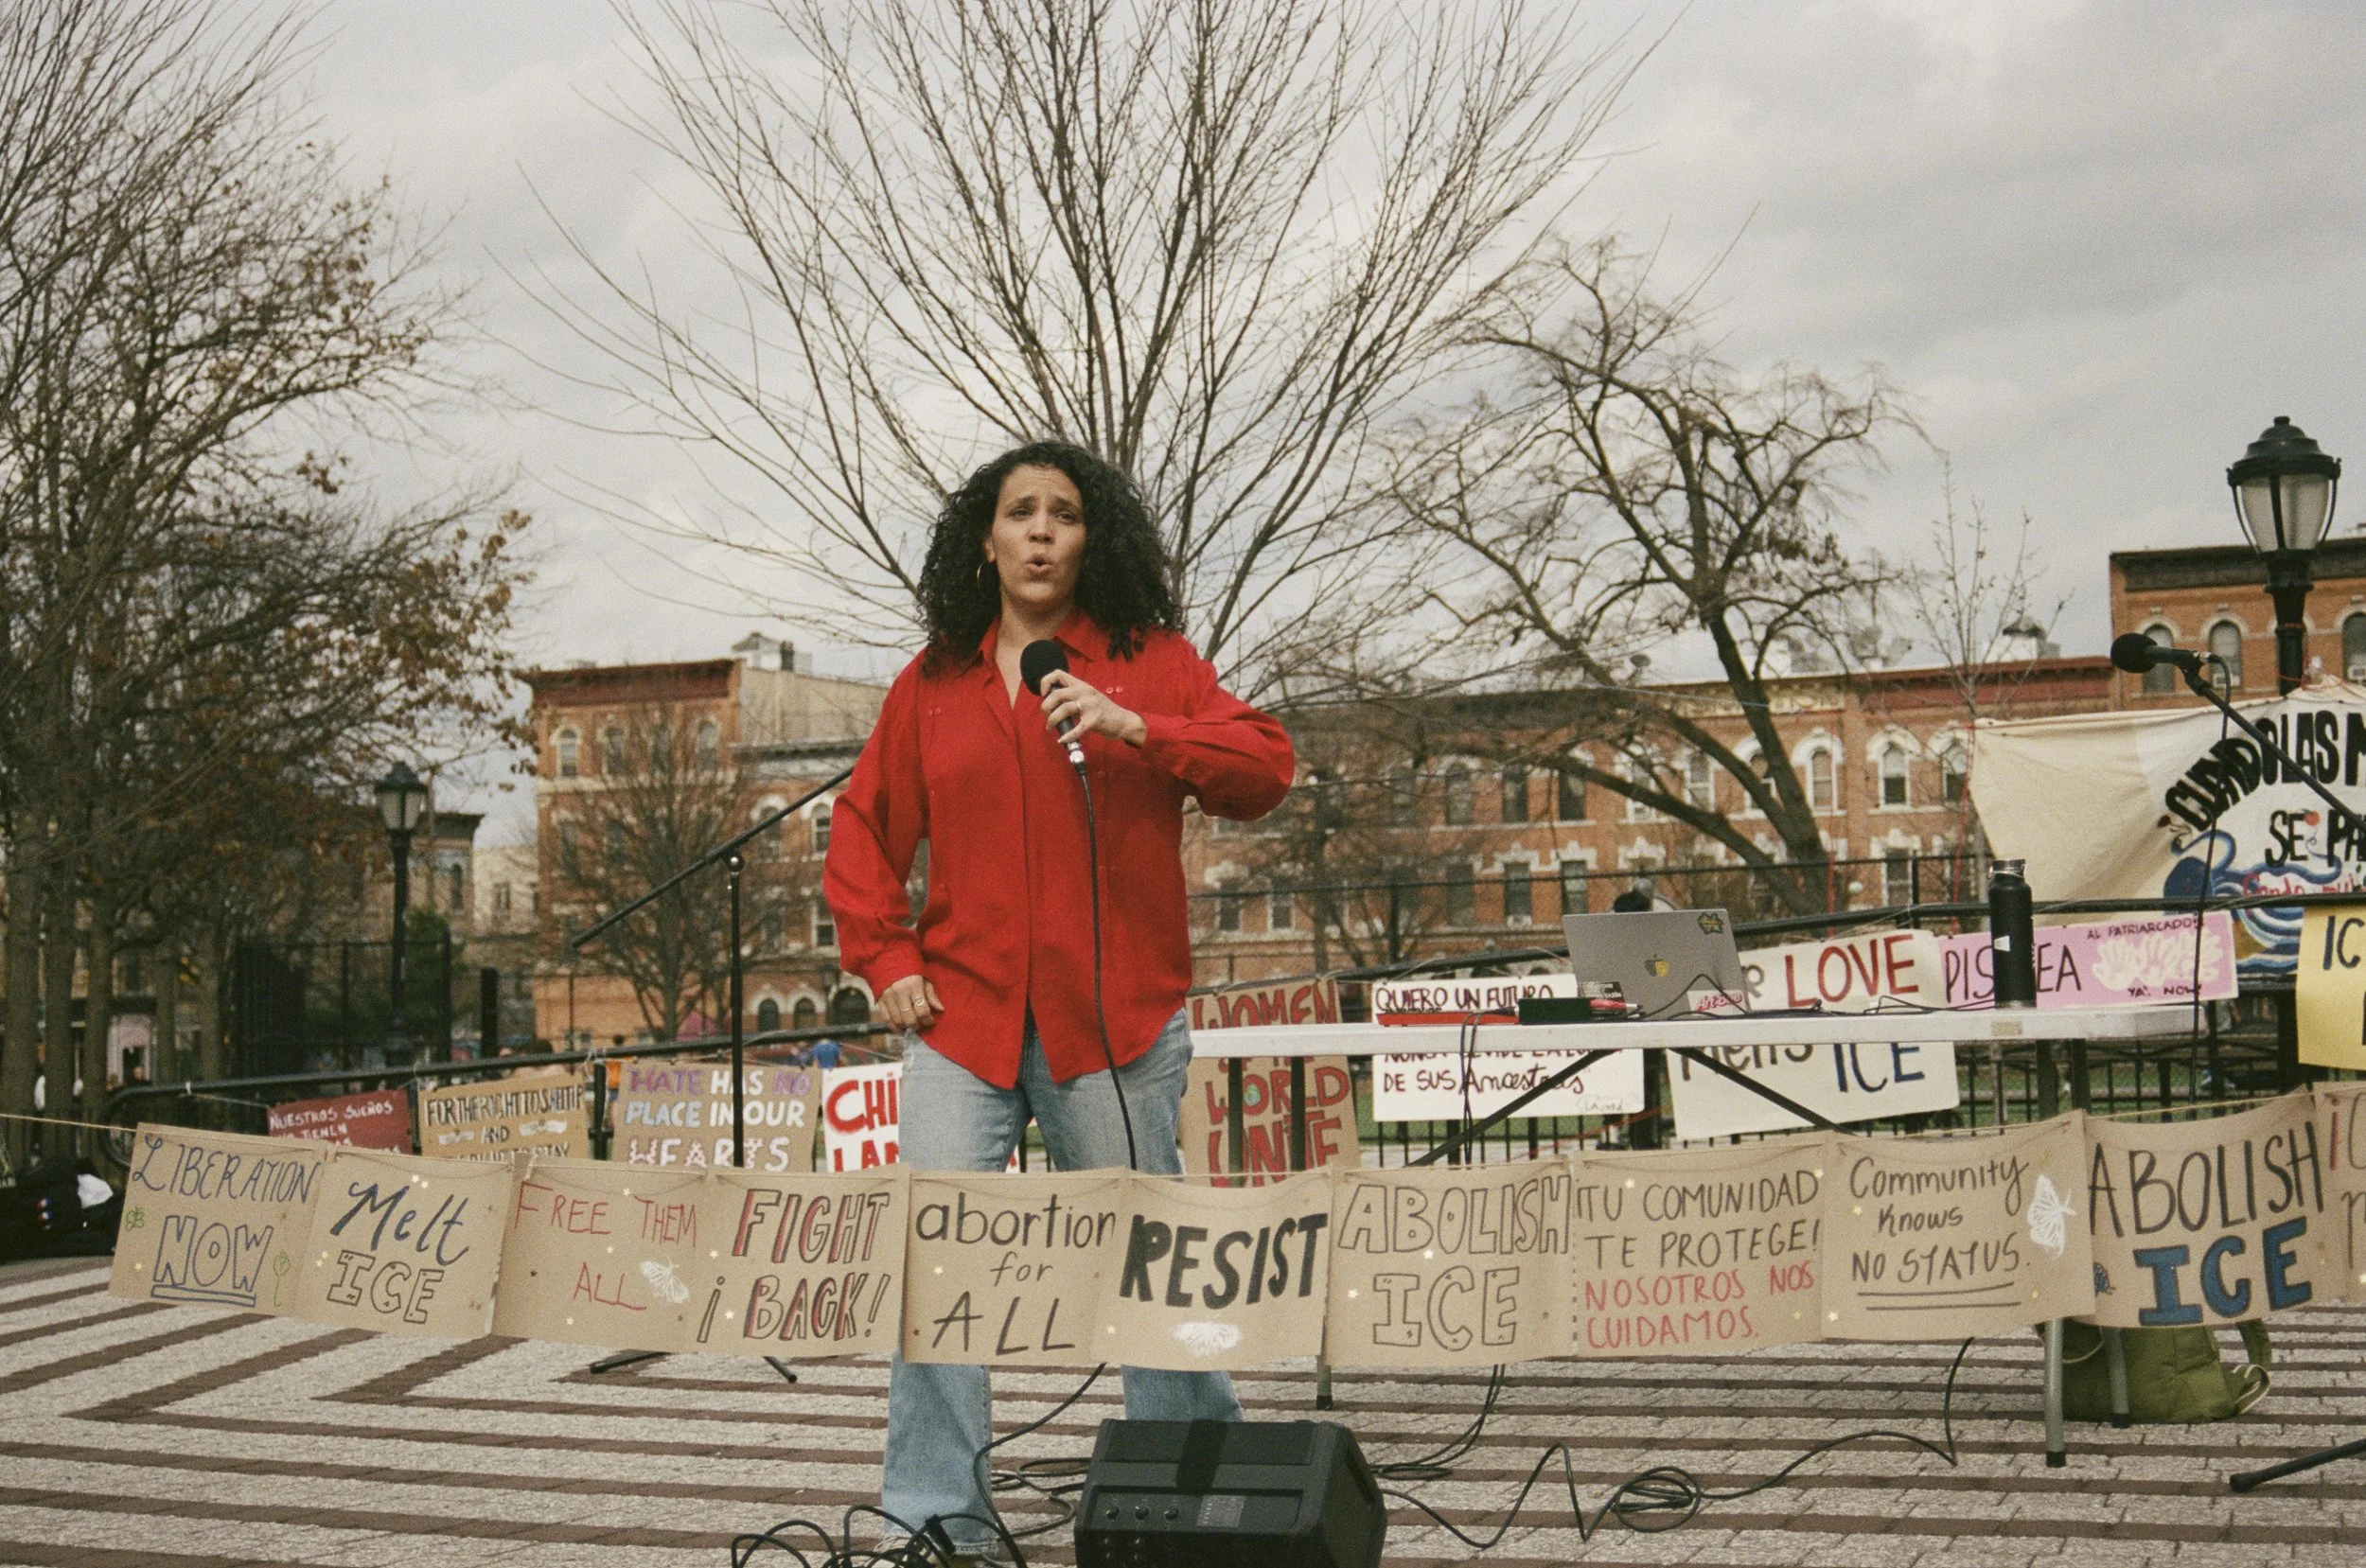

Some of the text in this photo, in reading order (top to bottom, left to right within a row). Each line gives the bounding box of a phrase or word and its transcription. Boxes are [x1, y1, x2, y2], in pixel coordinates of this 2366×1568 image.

[2281, 710, 2340, 784] LAS
[2265, 809, 2308, 867] SE
[2087, 926, 2101, 940] AL
[1784, 934, 1919, 1009] LOVE
[1945, 943, 2082, 1003] PISEA
[1192, 978, 1338, 1031] WOMEN
[1376, 987, 1448, 1012] QUIERO
[1456, 988, 1480, 1009] UN
[629, 1067, 703, 1095] HATE
[771, 1071, 811, 1096] NO
[1384, 1072, 1405, 1092] DE
[1416, 1070, 1456, 1090] SUS
[1833, 1043, 1925, 1093] ICE
[269, 1099, 394, 1131] NUESTROS SUEÑOS
[423, 1098, 455, 1127] FOR
[481, 1125, 510, 1145] AND
[625, 1101, 804, 1128] PLACE IN OUR
[131, 1134, 323, 1204] LIBERATION
[628, 1137, 790, 1172] HEARTS
[2087, 1120, 2325, 1239] ABOLISH
[1642, 1169, 1820, 1223] COMUNIDAD
[1849, 1154, 2031, 1217] Community
[329, 1180, 470, 1266] Melt
[514, 1181, 697, 1247] FREE THEM
[732, 1188, 891, 1265] FIGHT
[915, 1191, 1117, 1248] abortion
[1337, 1173, 1572, 1255] ABOLISH
[152, 1215, 274, 1293] NOW
[990, 1250, 1053, 1288] for
[1119, 1211, 1329, 1311] RESIST
[1583, 1218, 1821, 1270] TE PROTEGE!
[1851, 1248, 1886, 1283] NO
[2132, 1215, 2313, 1327] ICE
[327, 1250, 445, 1325] ICE
[572, 1261, 647, 1311] ALL
[1372, 1265, 1520, 1352] ICE
[1584, 1260, 1815, 1312] NOSOTROS NOS
[931, 1290, 1075, 1357] ALL
[1584, 1311, 1759, 1349] CUIDAMOS.
